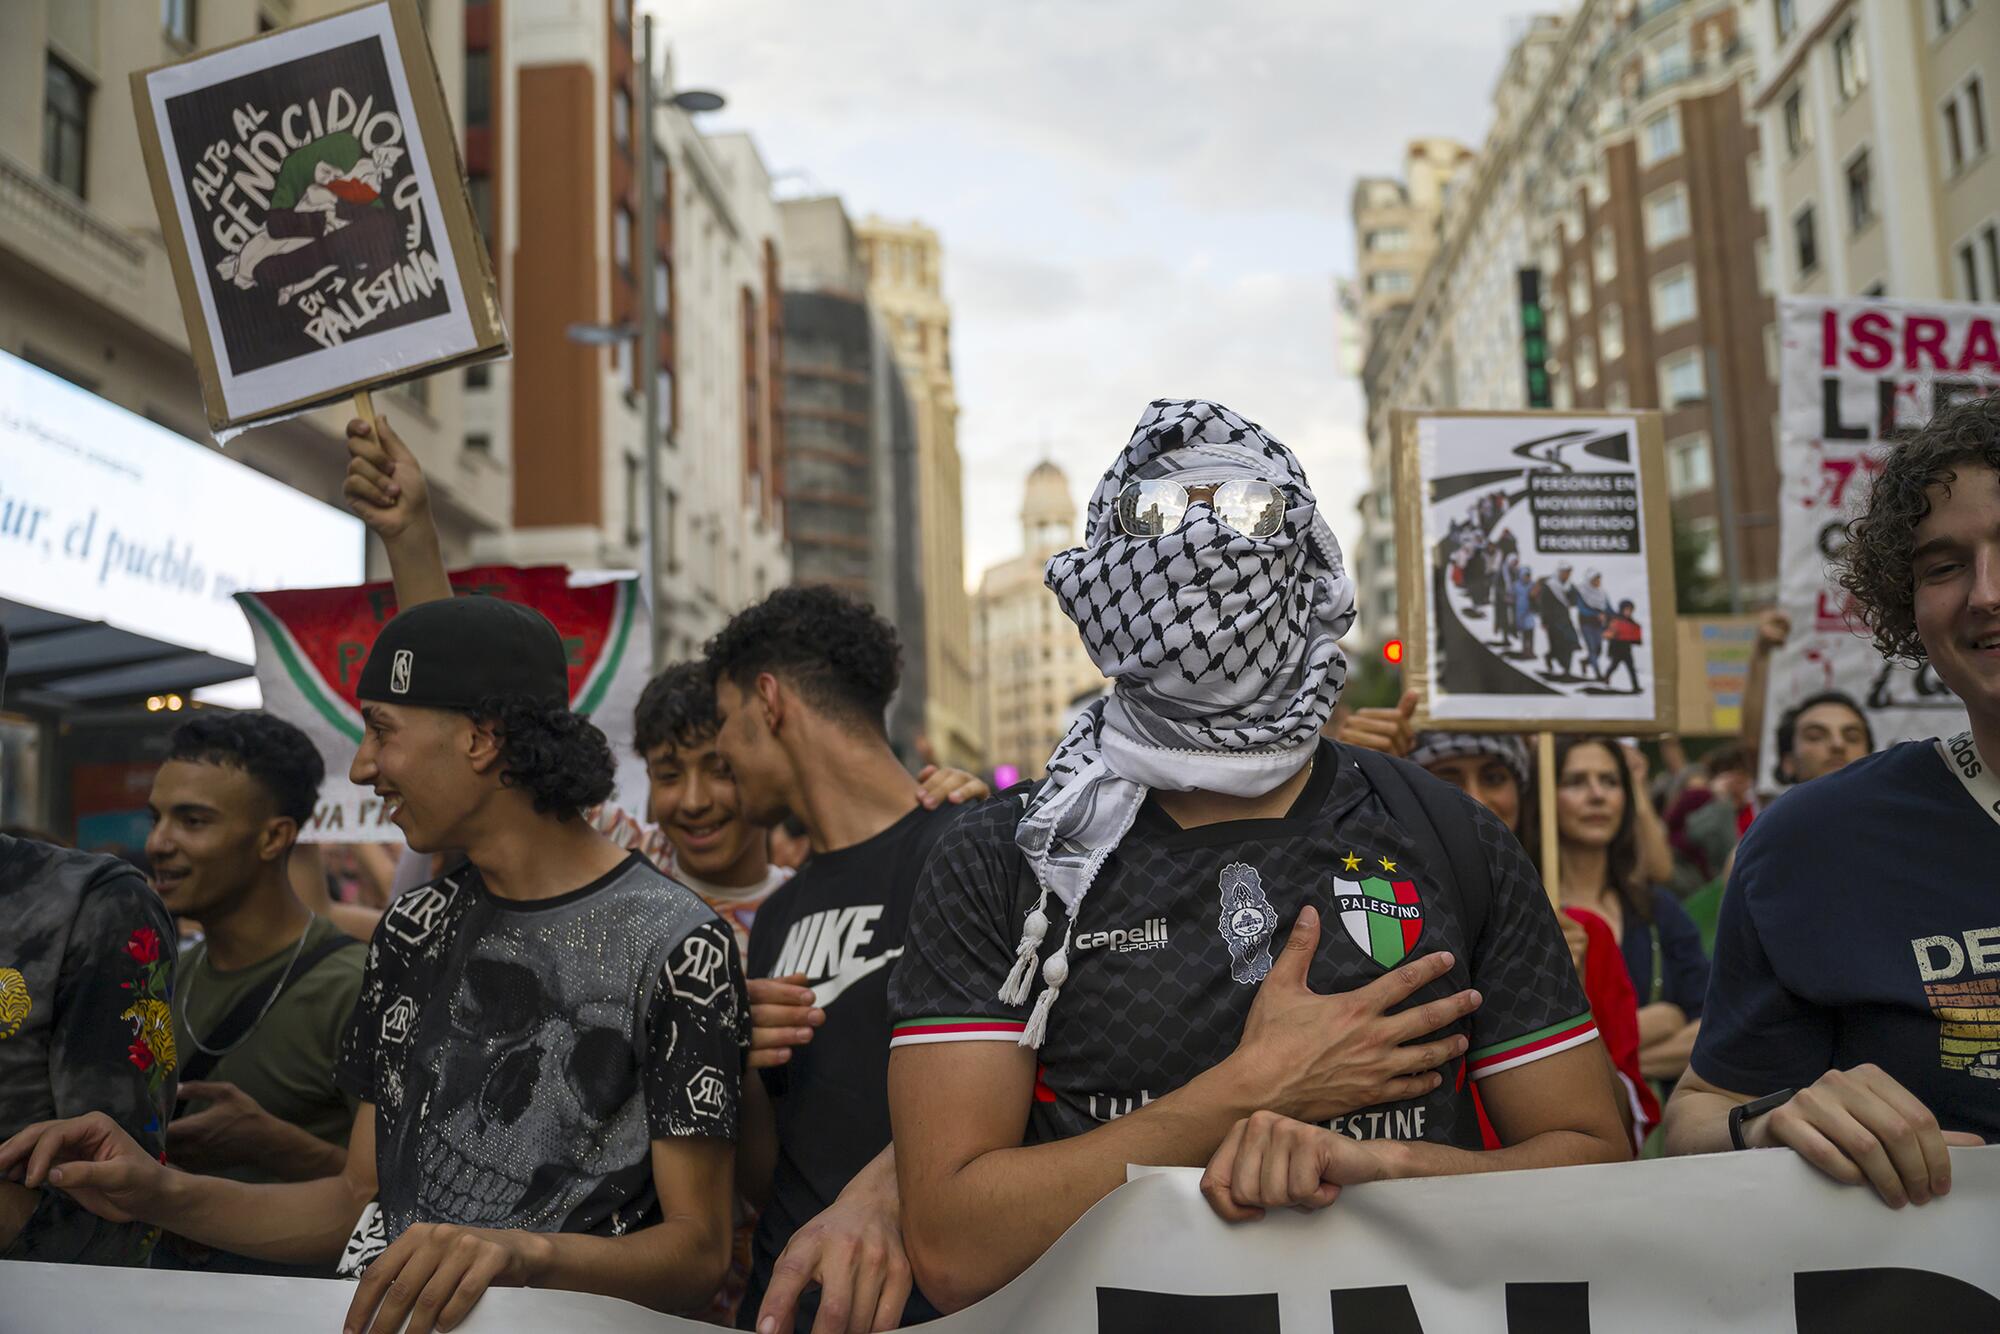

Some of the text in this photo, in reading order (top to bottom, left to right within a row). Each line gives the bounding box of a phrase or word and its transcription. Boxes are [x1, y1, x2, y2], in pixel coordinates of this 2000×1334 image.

[192, 102, 270, 211] ALTO AL
[213, 87, 403, 251] GENOCIDIO
[297, 287, 326, 317] EN
[303, 250, 444, 349] PALESTINA
[1822, 308, 2000, 373] ISRA
[1531, 475, 1635, 491] PERSONAS EN
[1533, 495, 1636, 511] MOVIMIENTO
[1538, 515, 1635, 531] ROMPIENDO
[0, 497, 51, 557] ur,
[63, 507, 97, 559] el
[98, 527, 206, 594] pueblo
[1539, 534, 1629, 550] FRONTERAS
[1340, 897, 1420, 918] PALESTINO
[768, 904, 885, 979] NIKE
[1075, 917, 1169, 951] capelli
[1119, 940, 1169, 953] SPORT
[1910, 926, 2000, 982] DE
[1329, 1105, 1426, 1142] ESTINE
